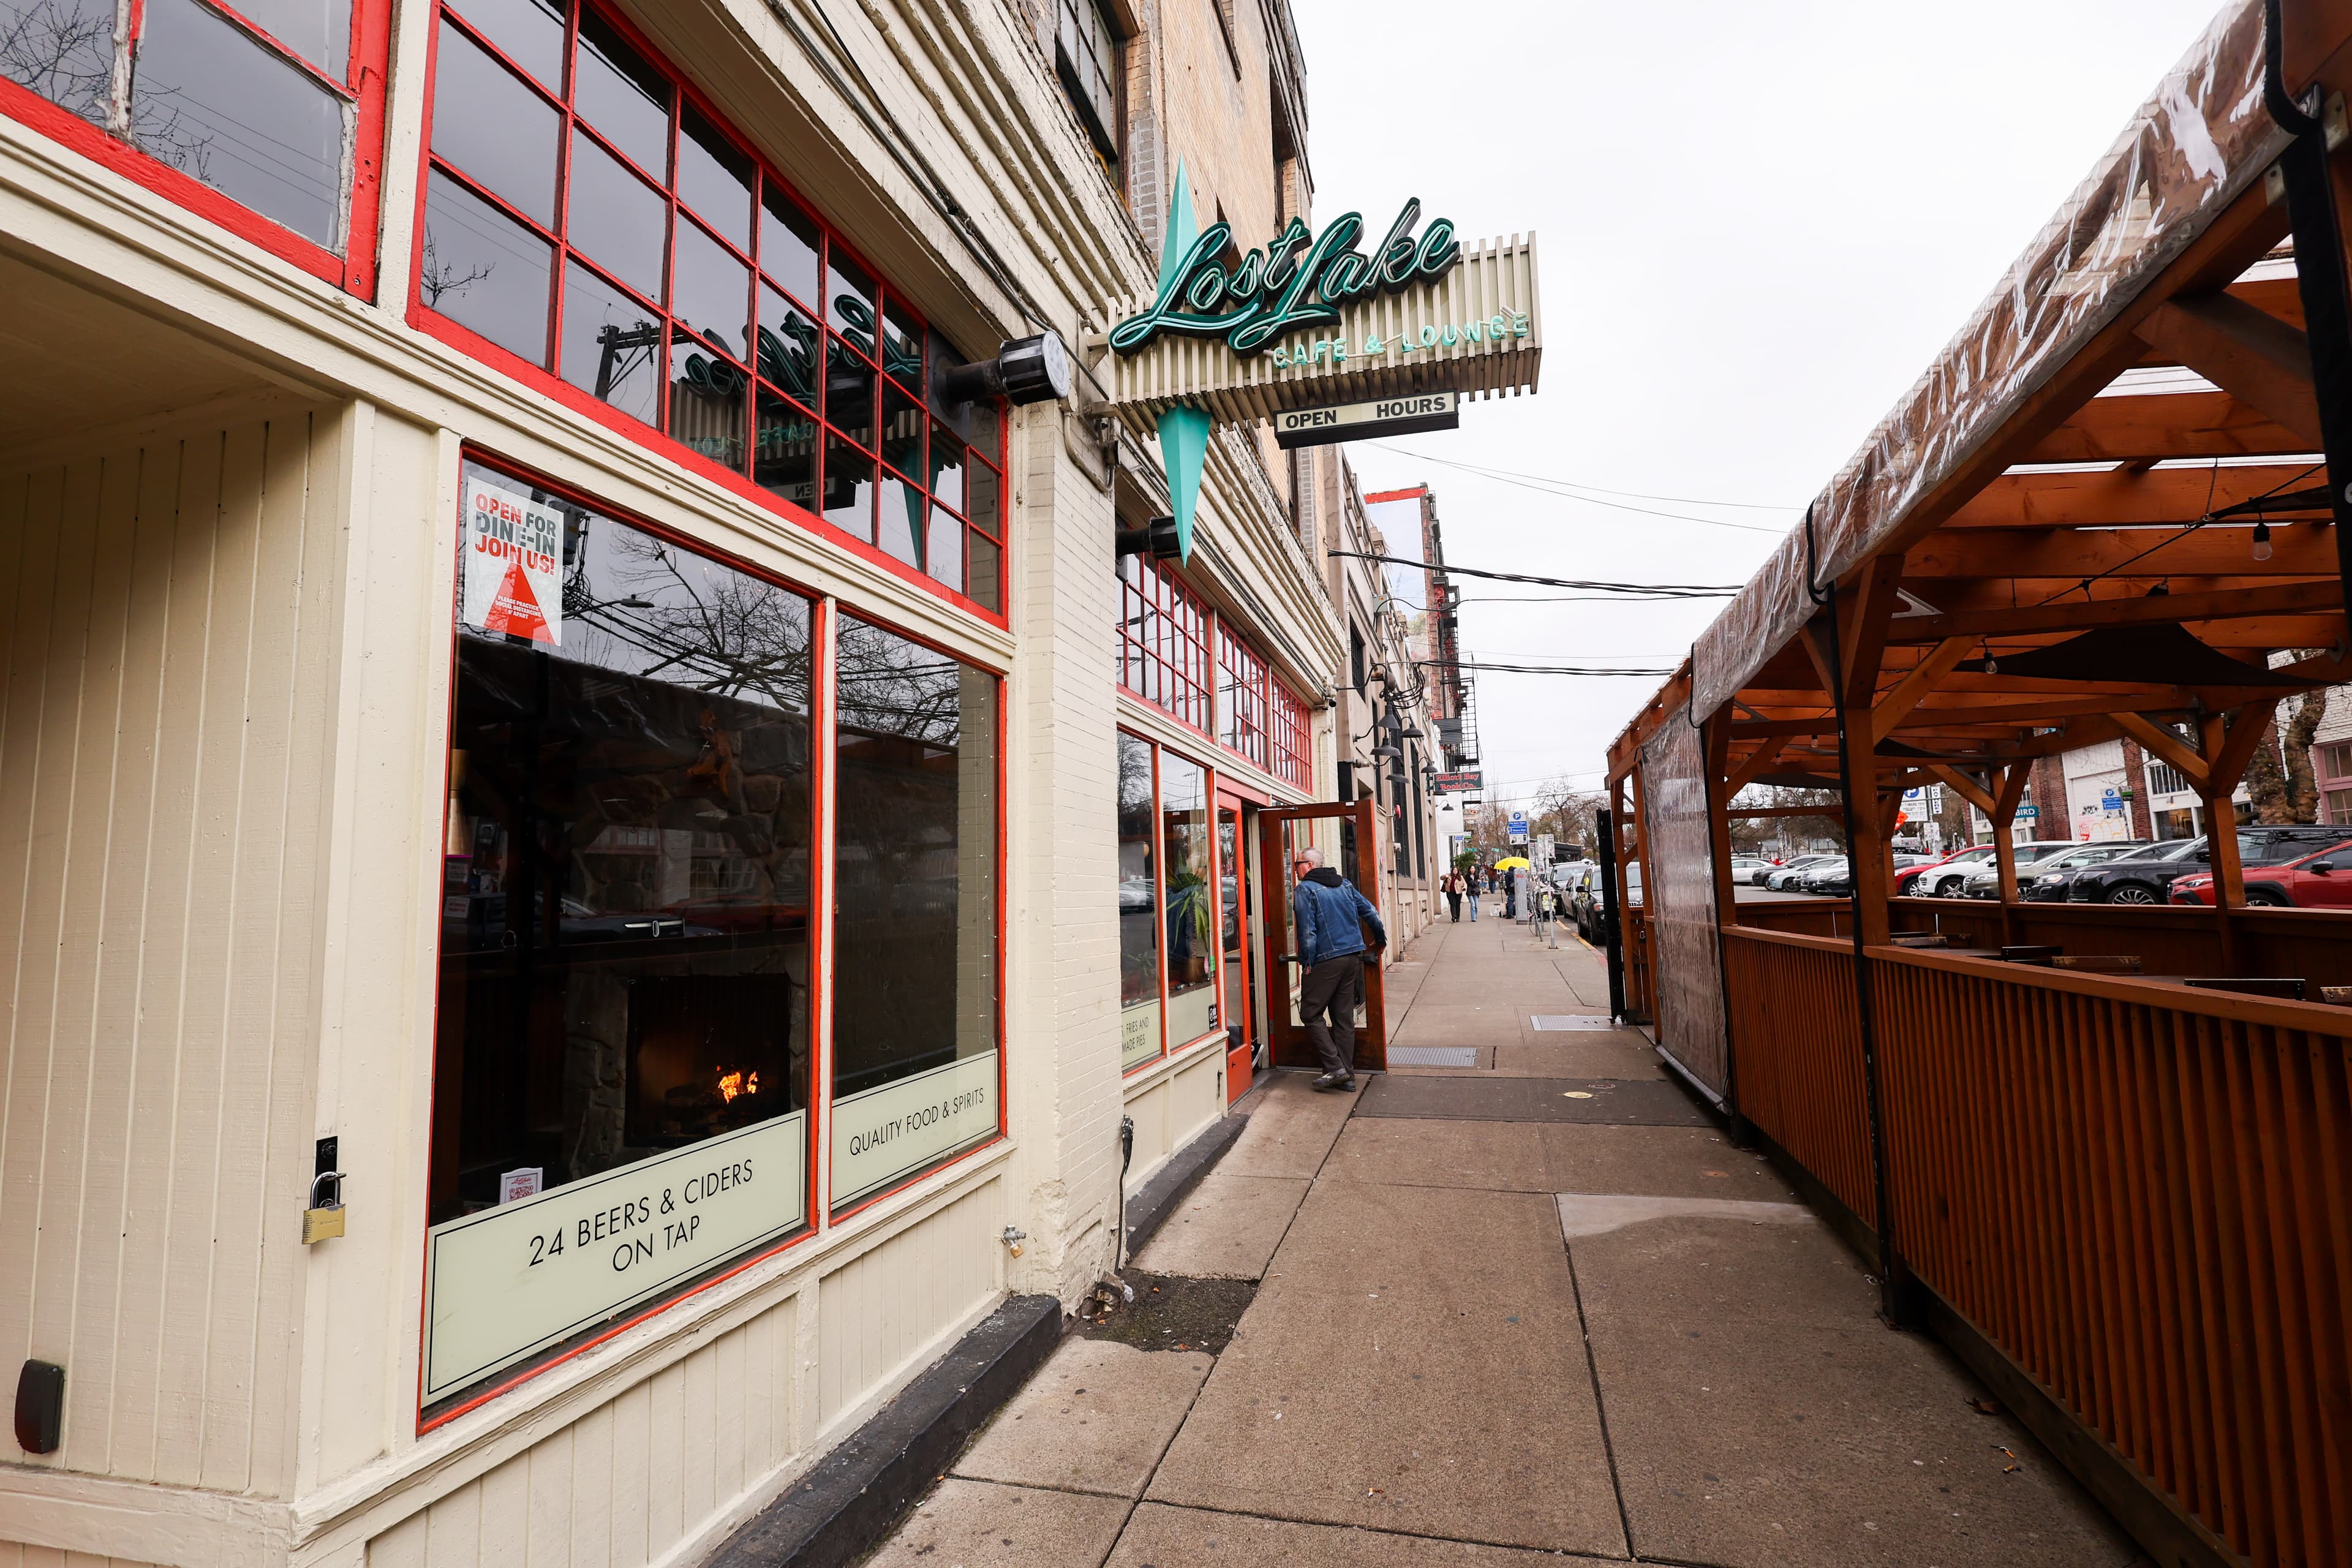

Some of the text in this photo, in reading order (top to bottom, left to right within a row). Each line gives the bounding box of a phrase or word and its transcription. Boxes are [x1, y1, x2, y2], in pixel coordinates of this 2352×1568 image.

[1108, 197, 1460, 359] Lost Lake
[1272, 311, 1529, 369] CAFE & LOUNGE
[1285, 396, 1446, 429] OPEN HOURS
[475, 493, 556, 537] OPEN FOR
[475, 511, 556, 557] DINE-IN
[475, 535, 555, 575] JOIN US!
[495, 600, 541, 617] SOCIAL DISTANCING
[497, 595, 539, 611] PLEASE PRACTICE
[1122, 1034, 1145, 1054] MADE PIES
[1126, 1020, 1138, 1034] FRIES
[1139, 1017, 1148, 1030] AND
[850, 1088, 984, 1156] QUALITY FOOD & SPIRITS
[529, 1159, 753, 1267] 24 BEERS & CIDERS
[612, 1215, 700, 1272] ON TAP
